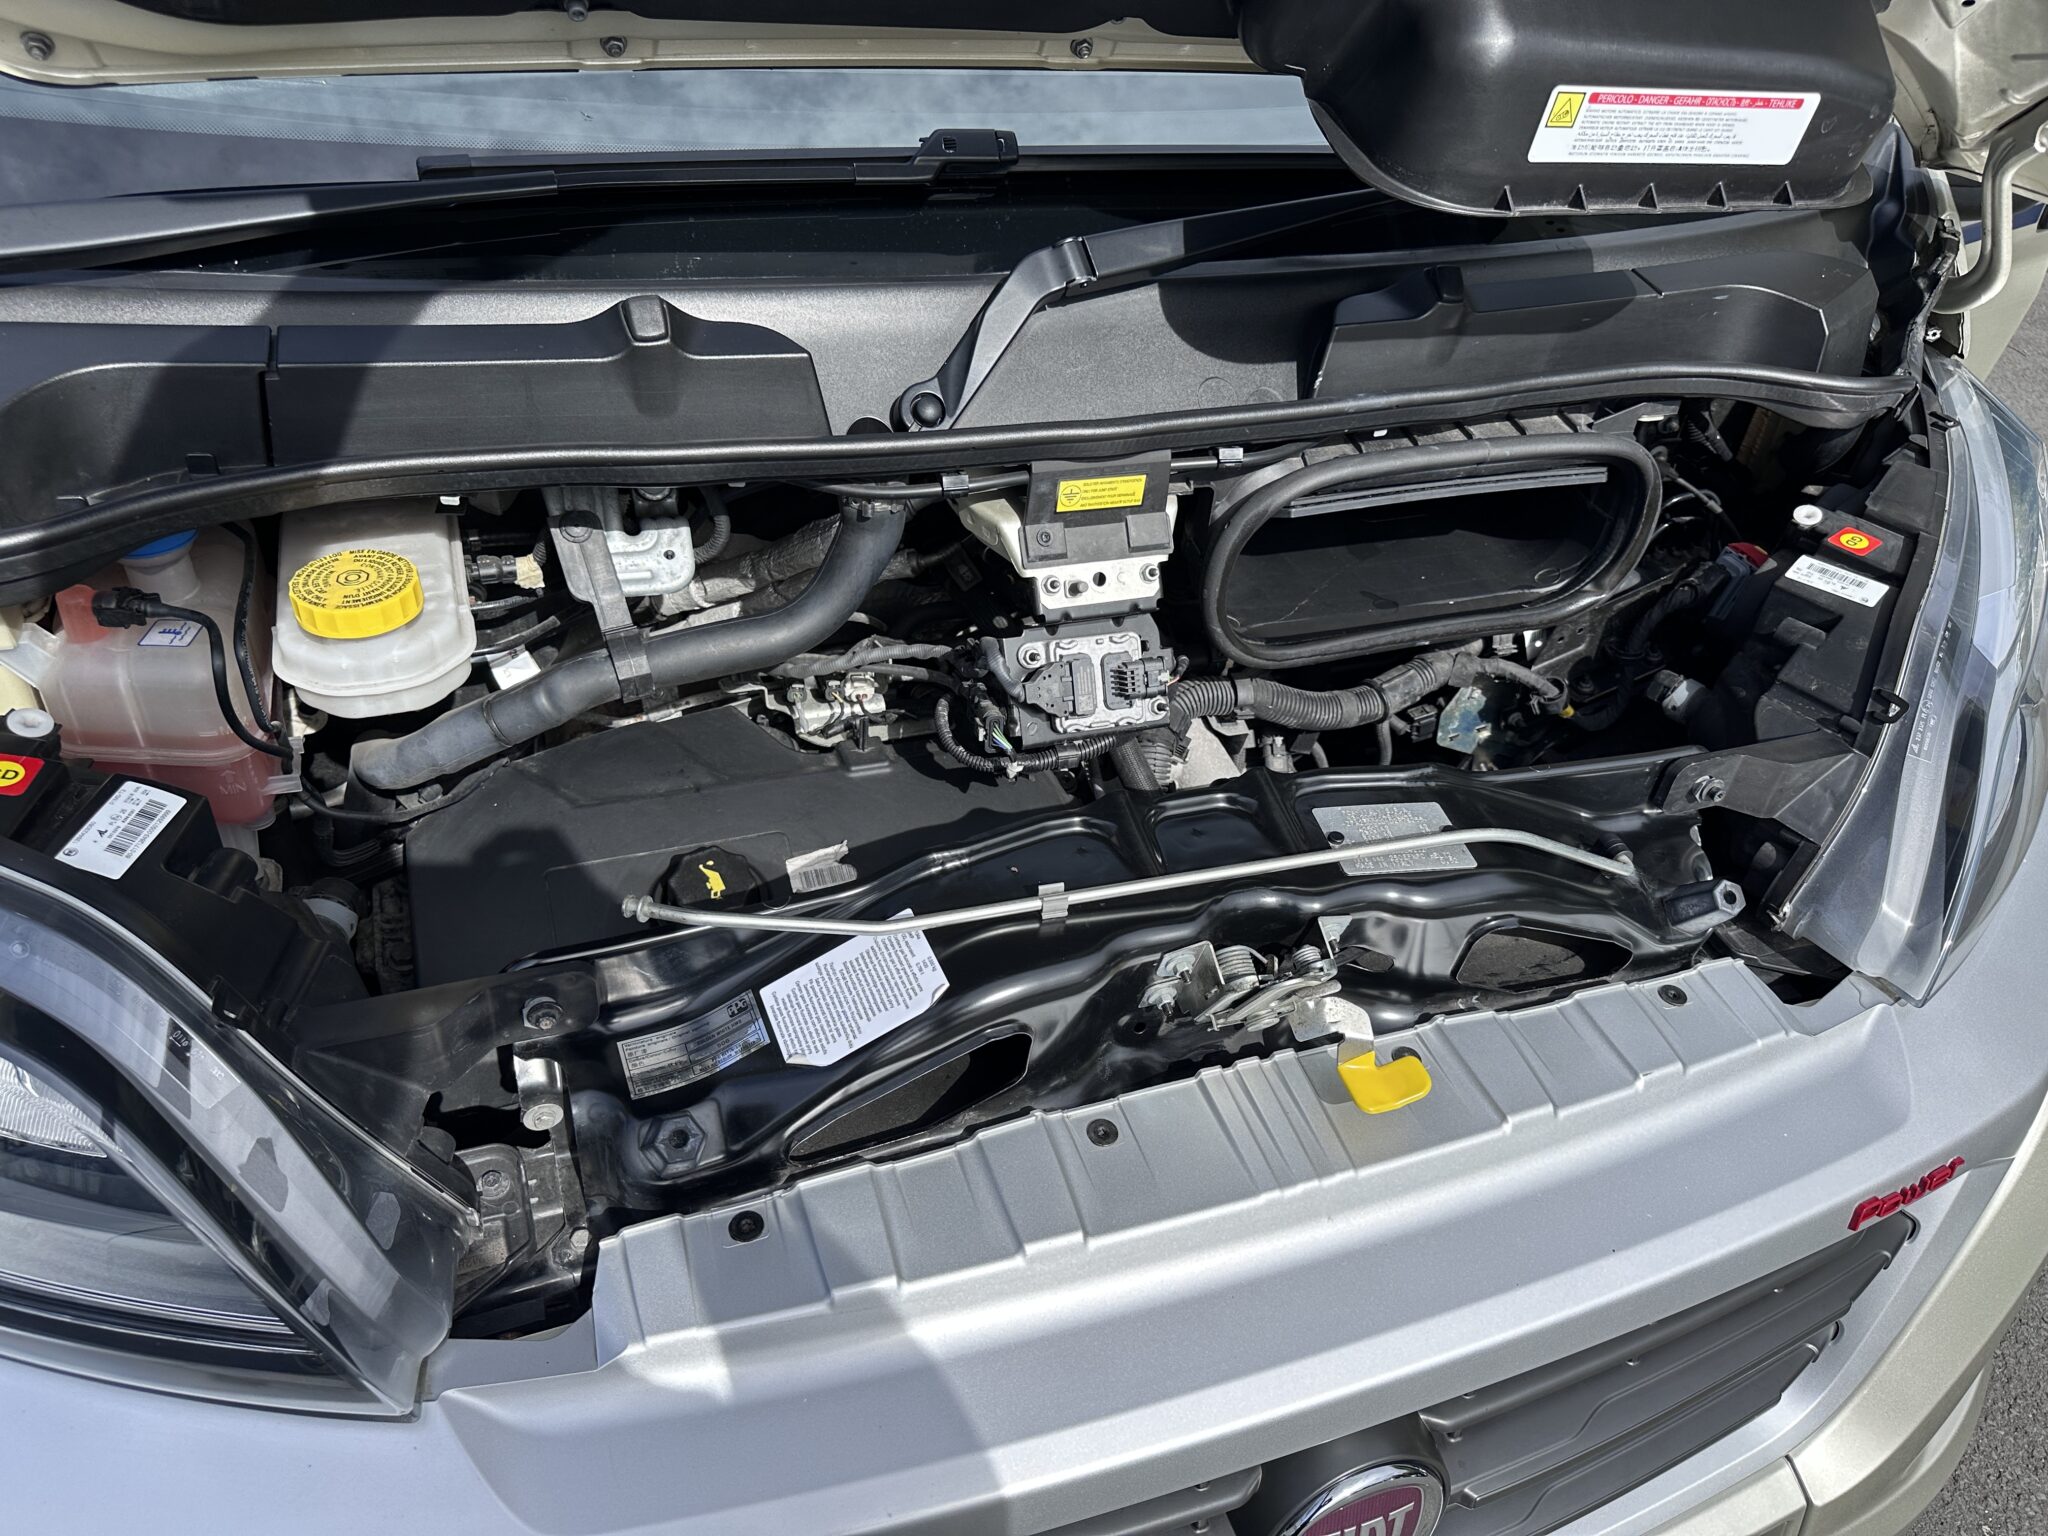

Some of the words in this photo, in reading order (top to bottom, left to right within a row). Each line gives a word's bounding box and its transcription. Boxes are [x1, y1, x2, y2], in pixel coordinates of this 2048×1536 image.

[1597, 94, 1634, 104] PERICOLO
[1638, 94, 1670, 104] DANGER
[1674, 96, 1702, 106] GEFAHR
[726, 998, 748, 1017] PPG
[1848, 1156, 1965, 1231] Power
[1322, 1502, 1414, 1536] AT
